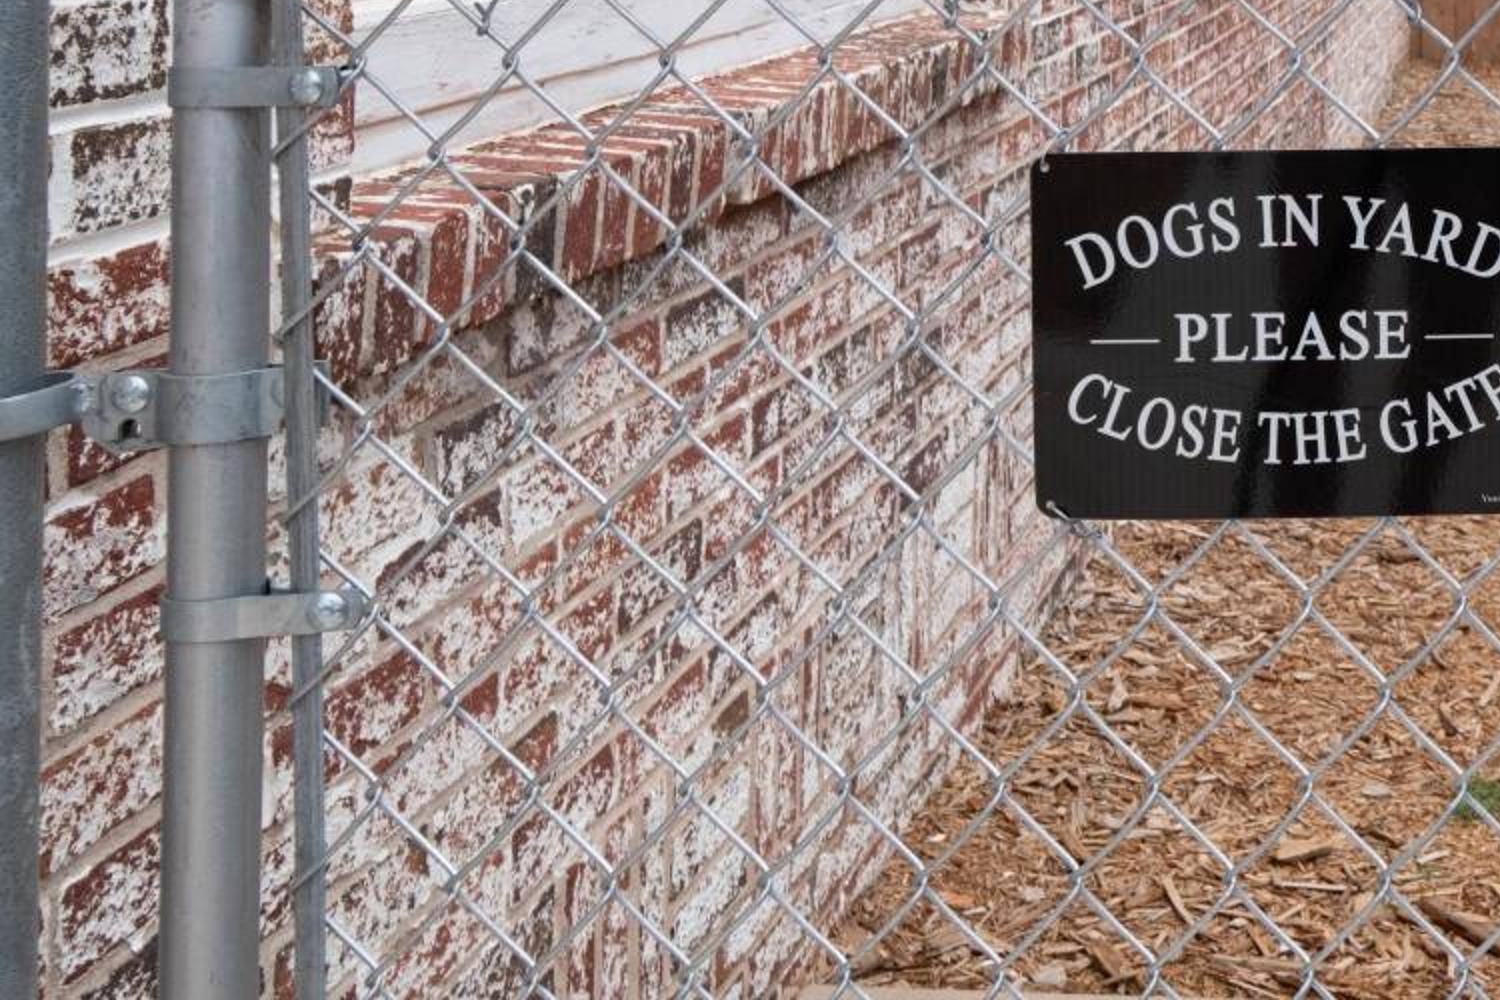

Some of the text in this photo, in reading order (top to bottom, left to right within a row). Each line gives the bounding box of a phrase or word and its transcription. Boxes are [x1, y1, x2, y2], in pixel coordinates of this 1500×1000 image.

[1064, 196, 1241, 290] DOGS
[1256, 194, 1323, 248] IN
[1173, 309, 1412, 363] PLEASE
[1067, 373, 1242, 463] CLOSE
[1257, 407, 1367, 465] THE
